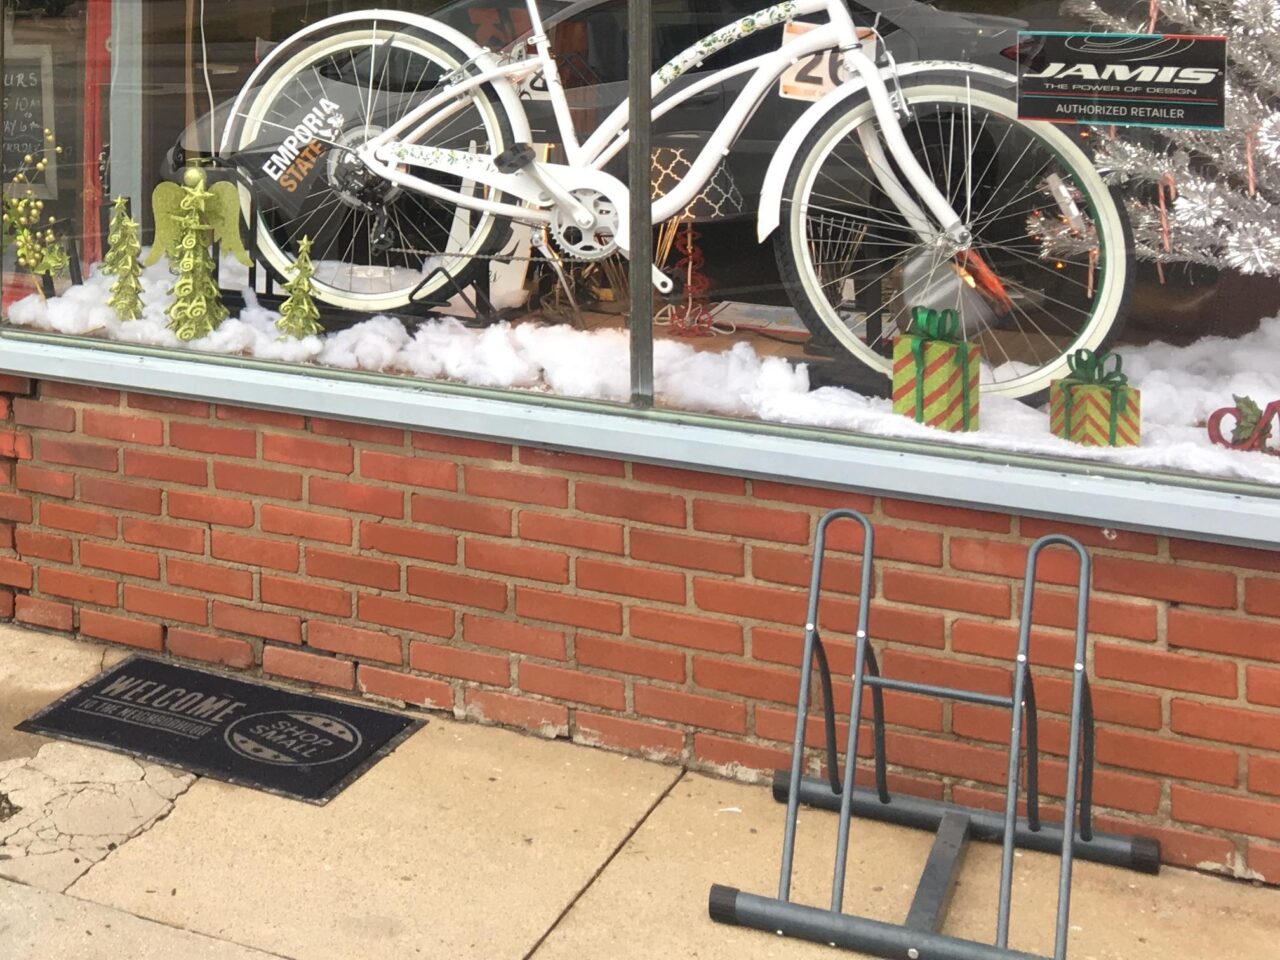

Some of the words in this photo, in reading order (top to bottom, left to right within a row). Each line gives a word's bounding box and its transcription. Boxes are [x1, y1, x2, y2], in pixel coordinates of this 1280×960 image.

[1022, 62, 1220, 84] JAMIS
[1072, 83, 1120, 92] POWER
[1146, 87, 1197, 95] DESIGN
[1056, 103, 1128, 117] AUTHORIZED
[1130, 107, 1185, 119] RETAILER
[262, 98, 340, 181] EMPORIA
[279, 137, 326, 193] STATE
[78, 698, 97, 709] TO
[98, 701, 122, 715] THE
[100, 675, 247, 723] WELCOME
[249, 723, 316, 758] SMALL
[269, 720, 333, 749] SHOP
